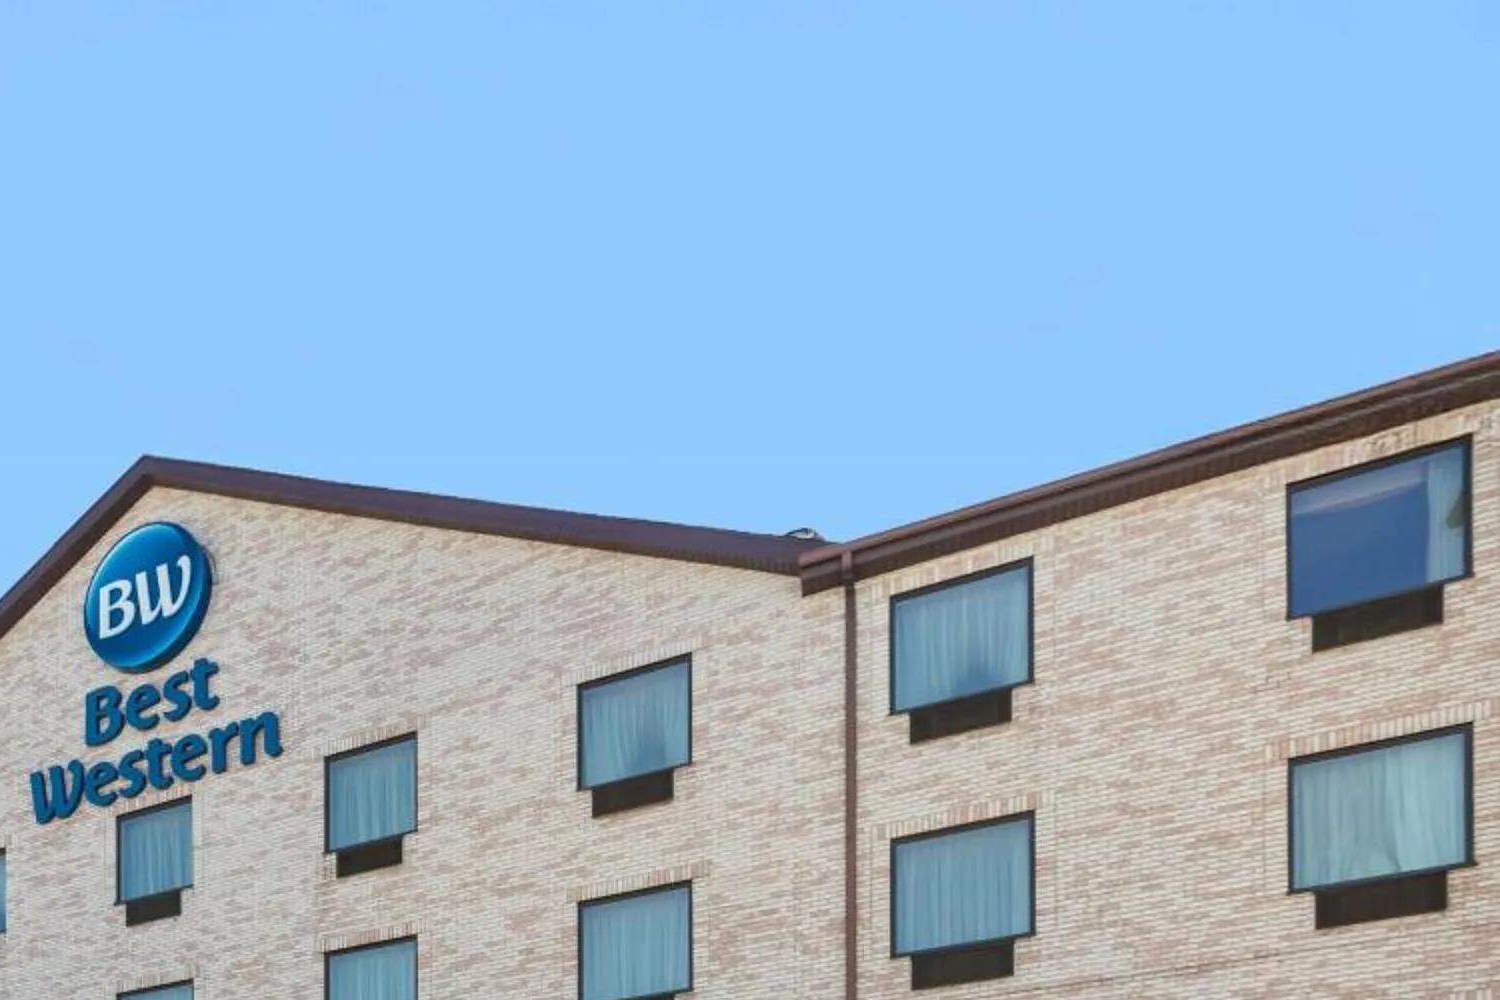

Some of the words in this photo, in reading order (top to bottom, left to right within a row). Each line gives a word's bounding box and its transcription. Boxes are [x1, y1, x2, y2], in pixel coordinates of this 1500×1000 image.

[100, 555, 192, 640] BW
[85, 658, 220, 747] Best
[29, 711, 284, 825] Western
